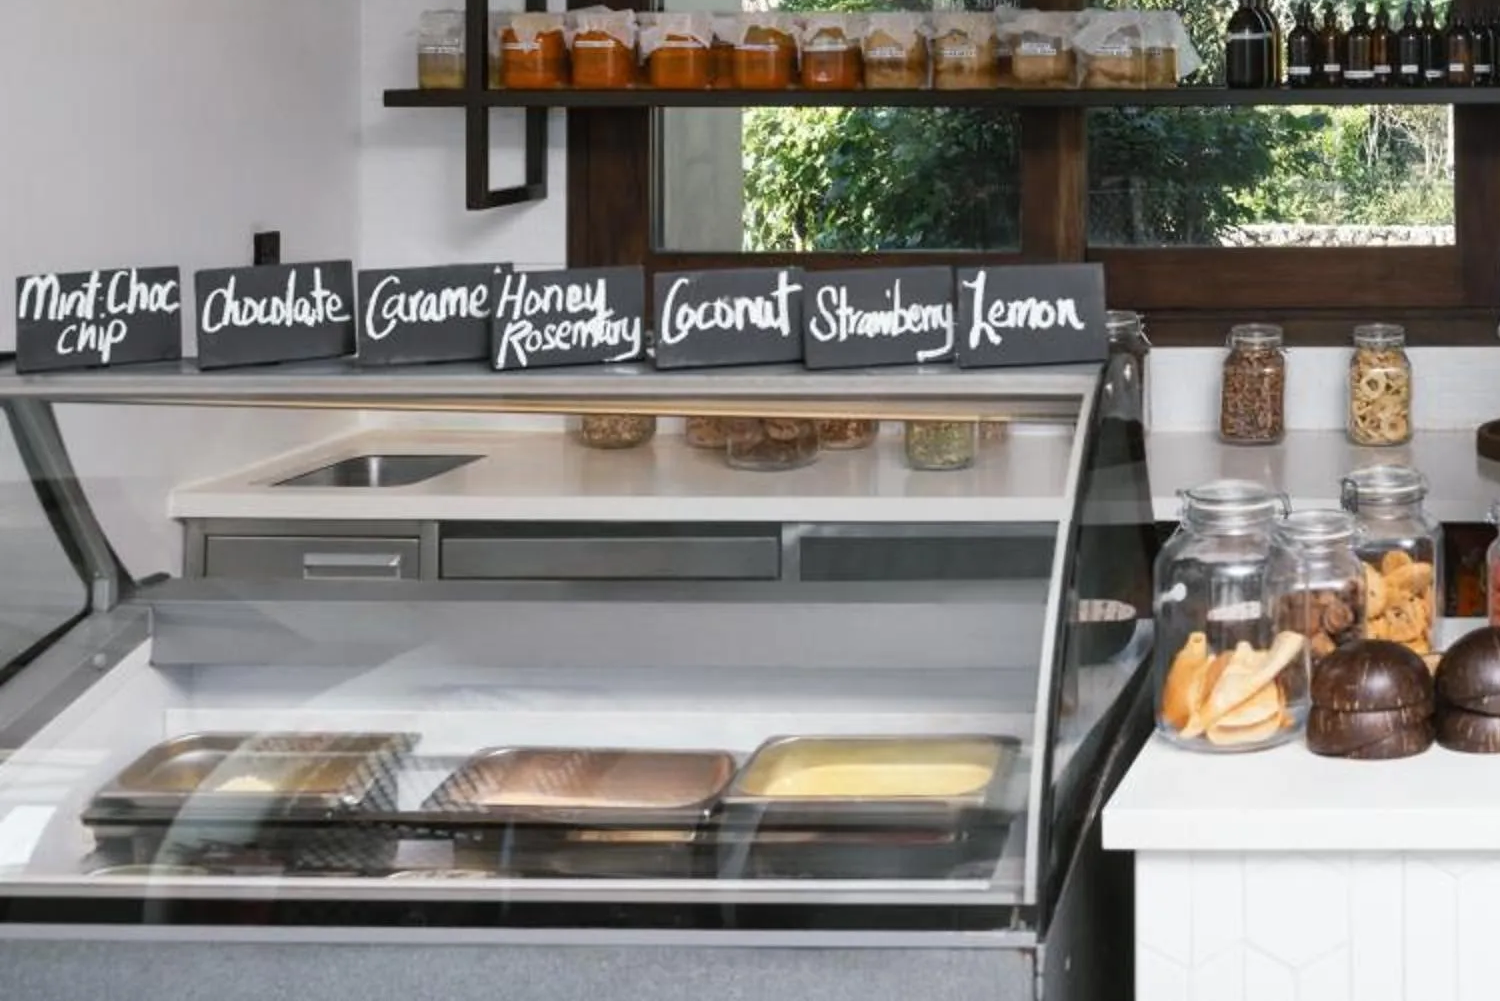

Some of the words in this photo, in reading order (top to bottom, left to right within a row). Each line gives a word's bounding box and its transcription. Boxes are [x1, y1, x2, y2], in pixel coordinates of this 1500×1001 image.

[106, 267, 181, 315] Choc
[201, 266, 351, 334] Chocolate
[365, 274, 491, 341] Carame
[496, 273, 615, 320] Honey
[659, 270, 804, 346] Coconut
[962, 269, 1086, 350] Lemon
